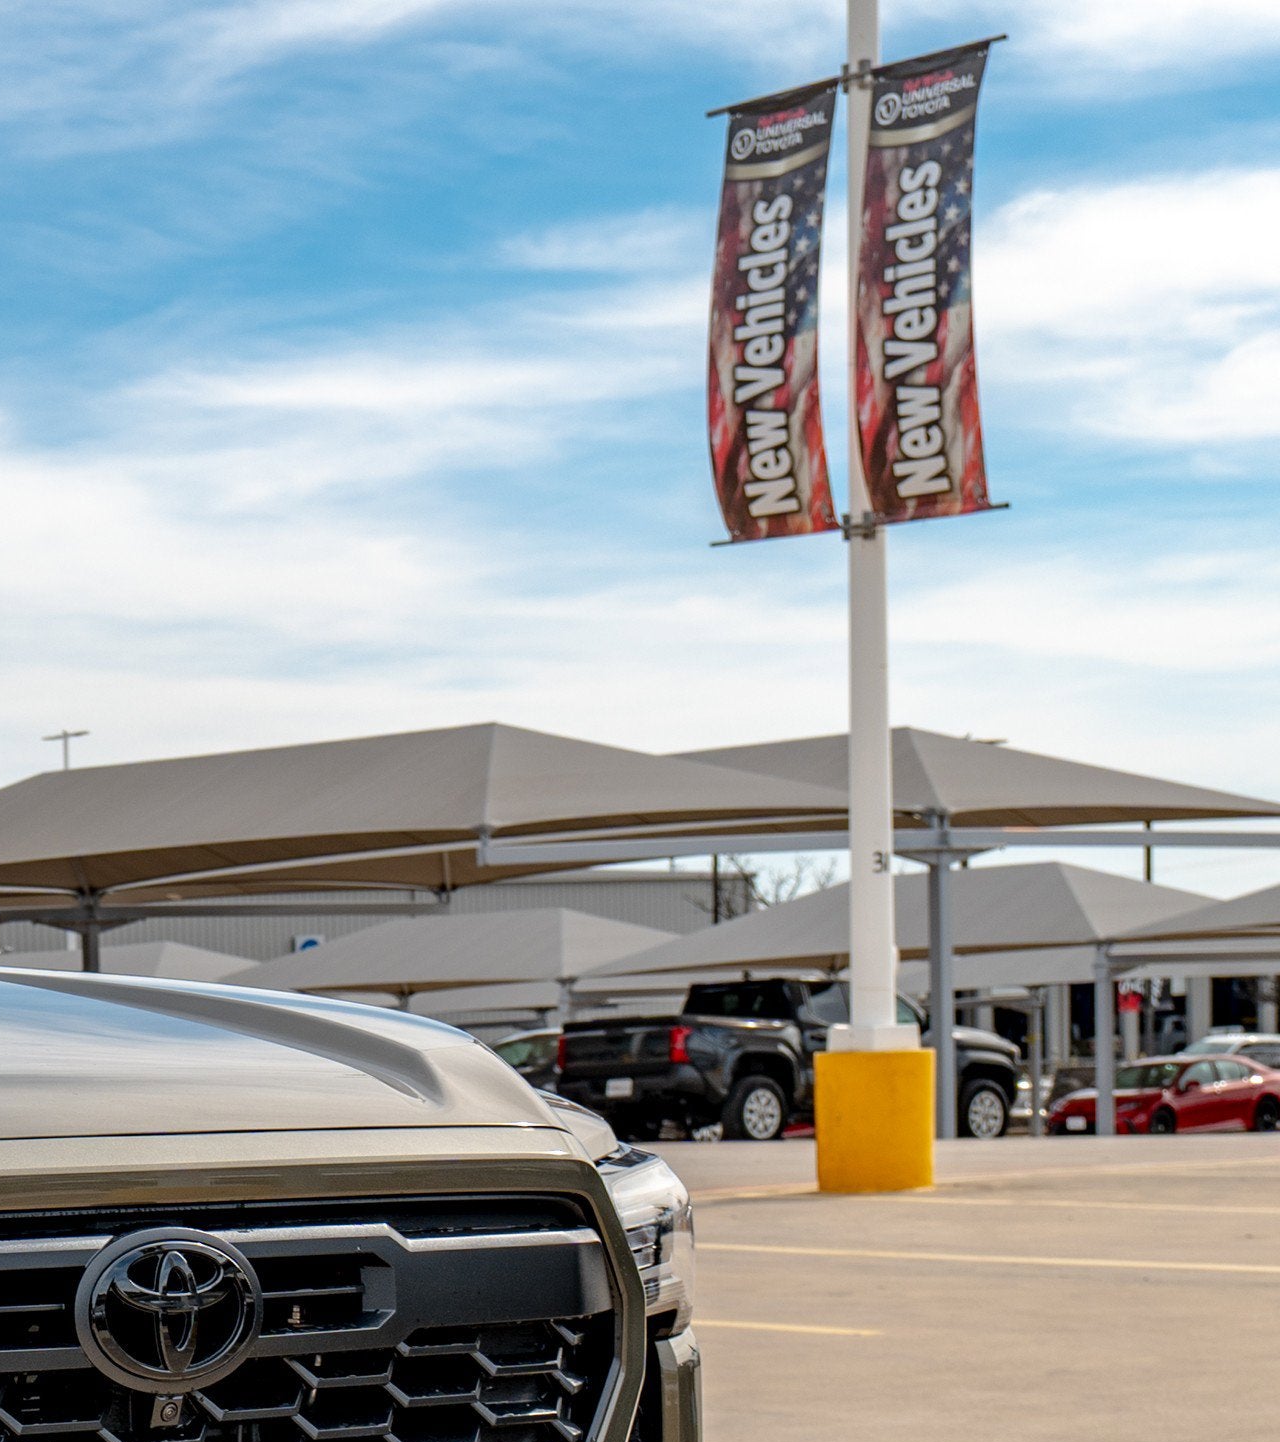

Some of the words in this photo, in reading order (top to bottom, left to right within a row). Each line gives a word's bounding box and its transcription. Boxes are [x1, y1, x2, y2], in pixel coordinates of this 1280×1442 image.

[755, 131, 803, 155] TOYOTA
[901, 95, 951, 120] TOYOTA
[902, 74, 977, 106] UNIVERSAL
[734, 194, 794, 405] Vehicles
[884, 160, 941, 380] Vehicles
[744, 410, 800, 518] New
[892, 385, 953, 498] New
